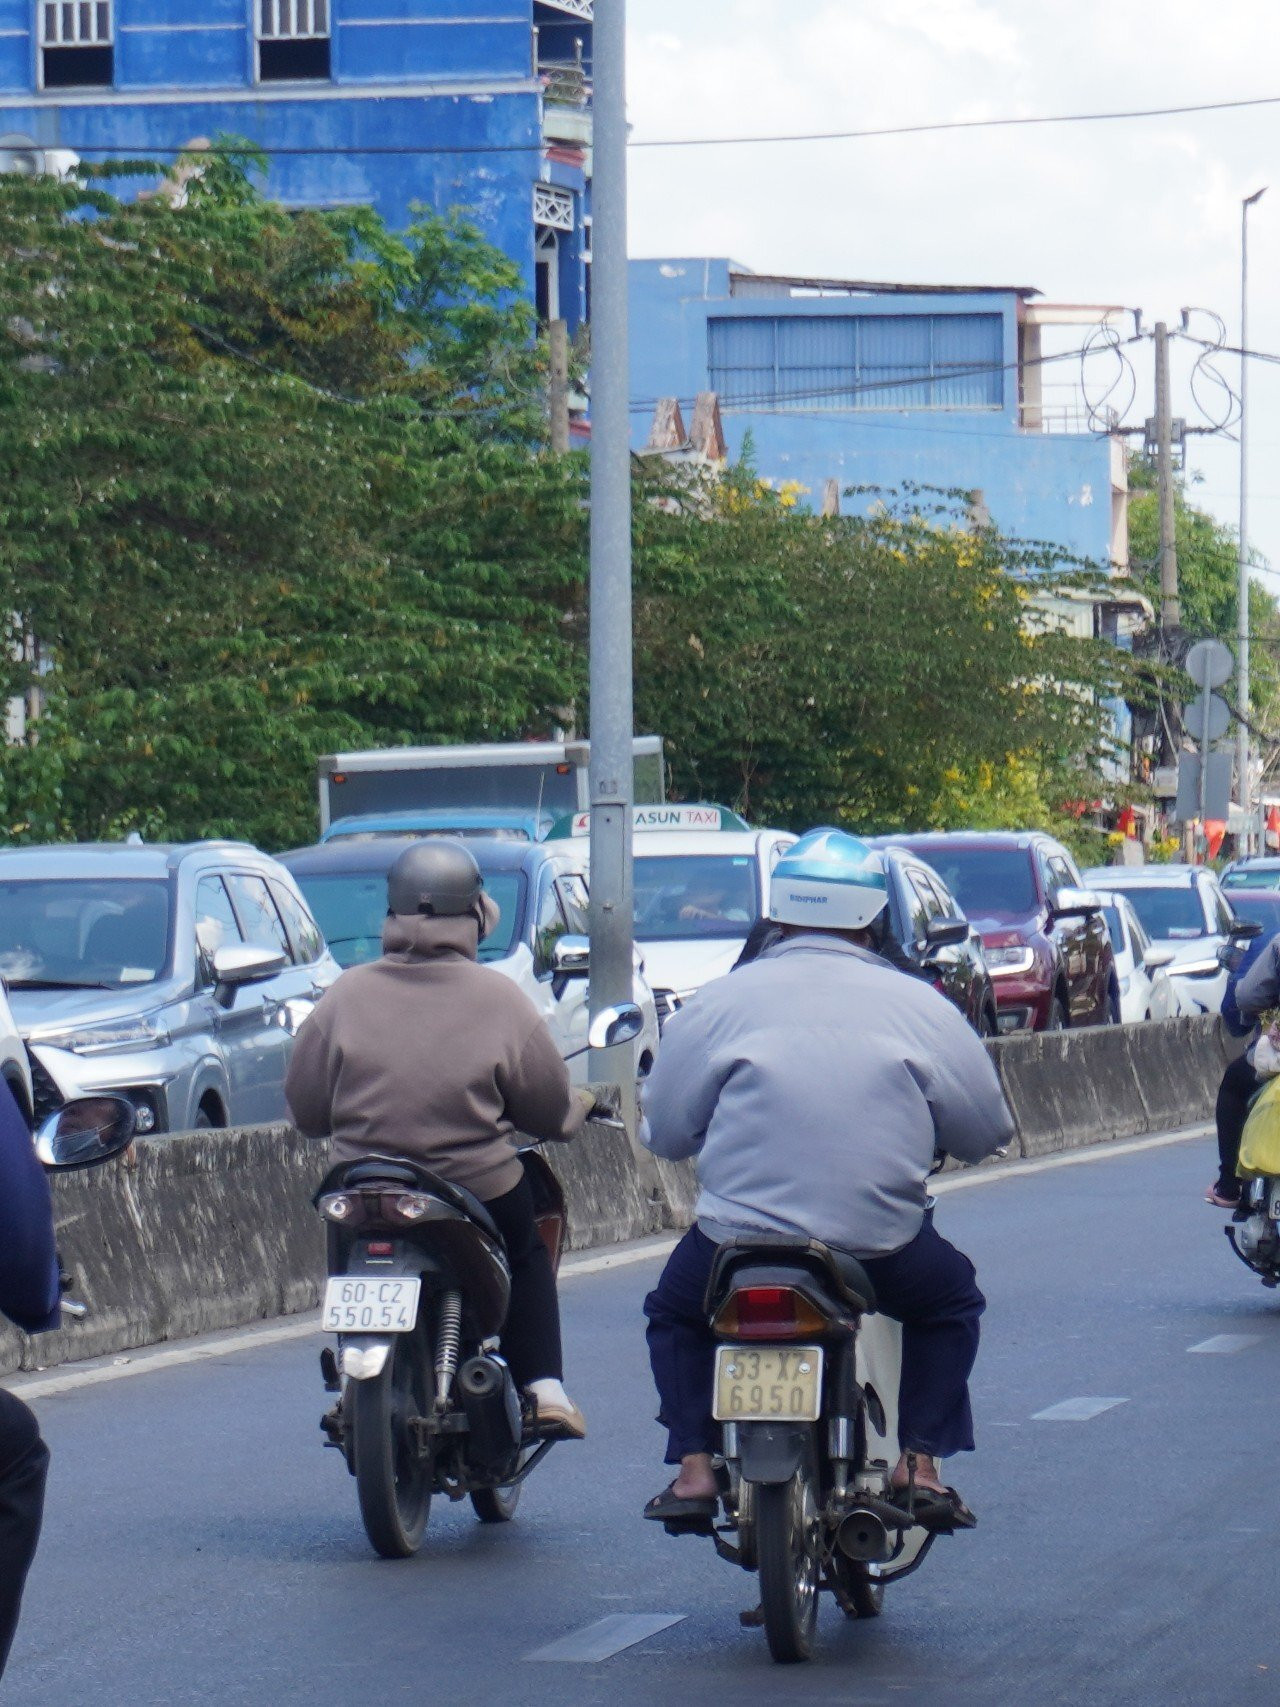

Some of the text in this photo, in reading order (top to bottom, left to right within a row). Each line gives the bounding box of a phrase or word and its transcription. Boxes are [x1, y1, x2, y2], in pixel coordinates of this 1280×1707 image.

[635, 811, 717, 825] ASUN TAXI
[329, 1306, 407, 1328] 550.54
[730, 1385, 804, 1414] 6950
